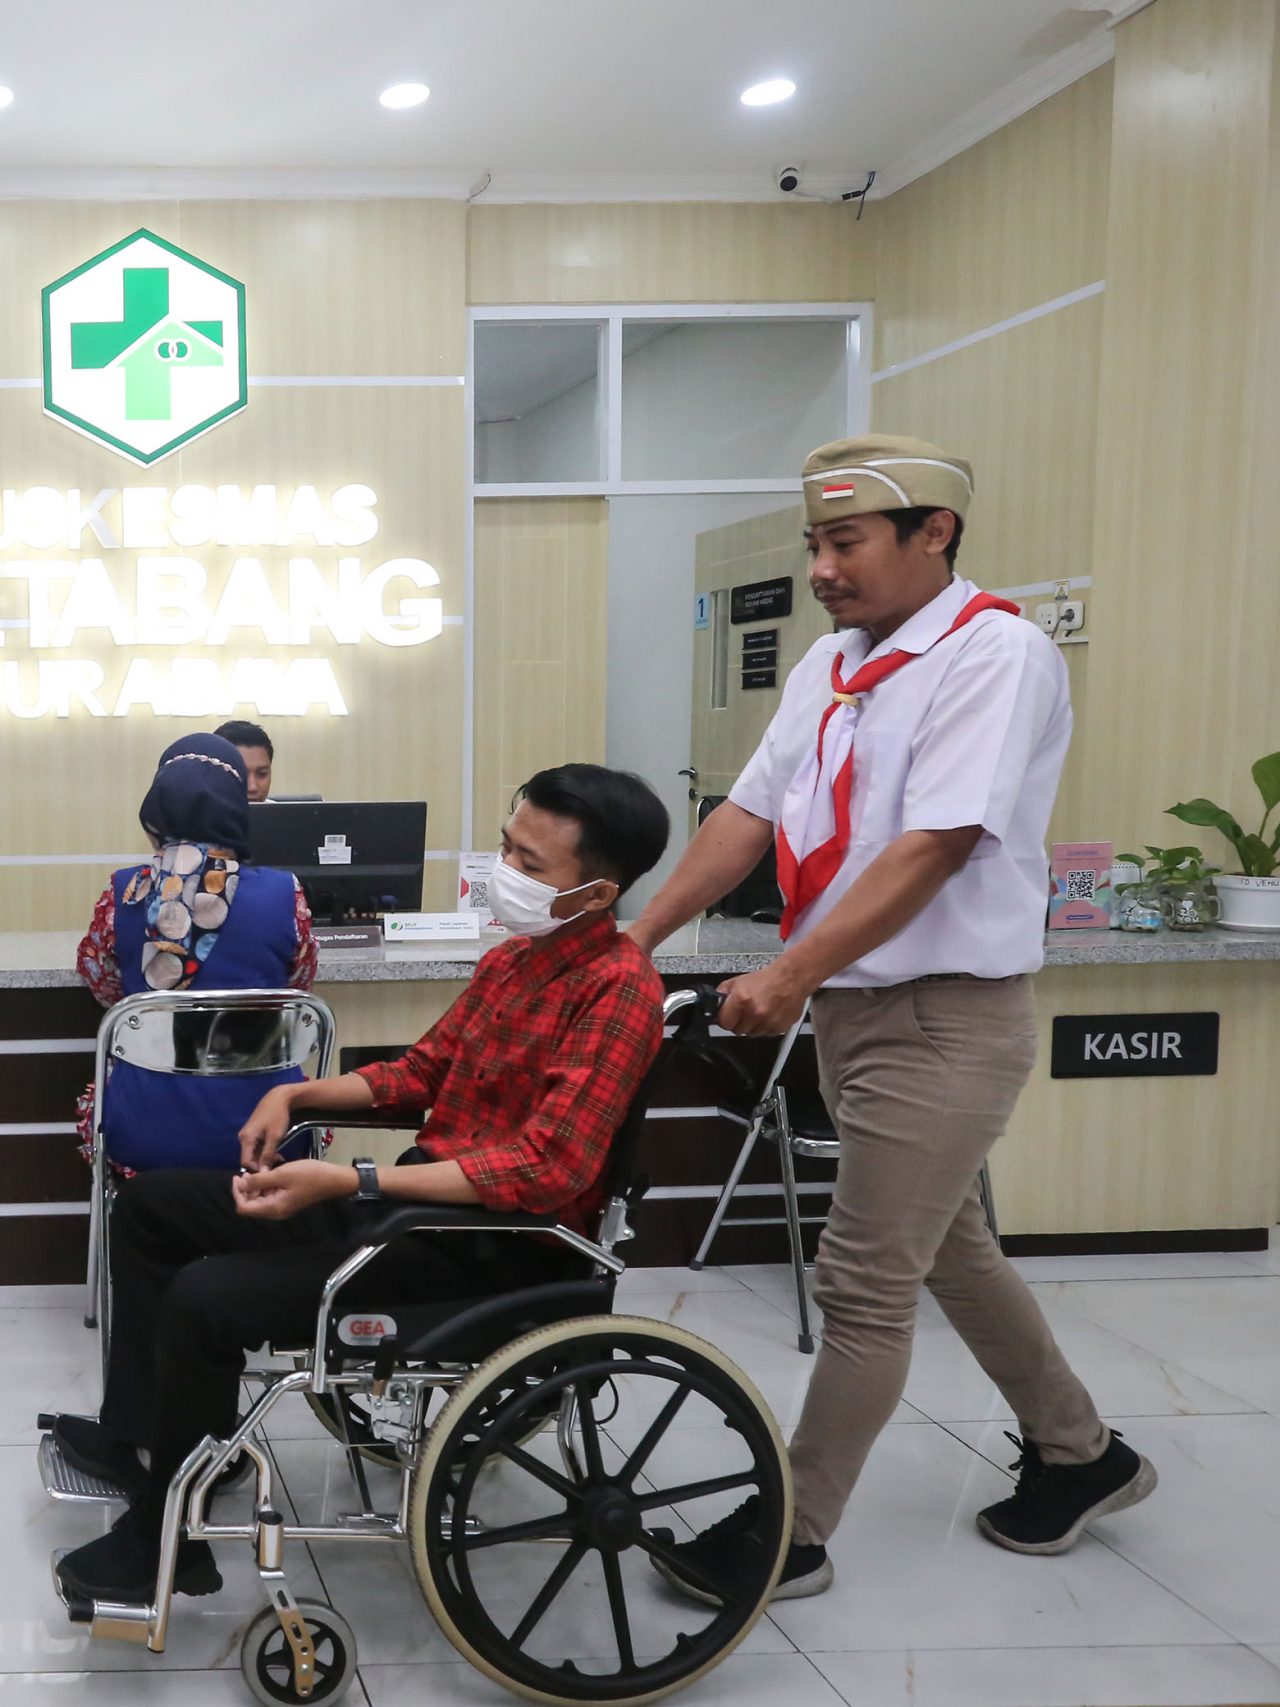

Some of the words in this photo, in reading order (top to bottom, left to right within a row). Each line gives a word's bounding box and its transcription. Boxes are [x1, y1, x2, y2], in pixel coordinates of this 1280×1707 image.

[698, 598, 704, 618] 1
[1084, 1031, 1183, 1061] KASIR
[350, 1320, 385, 1336] GEA
